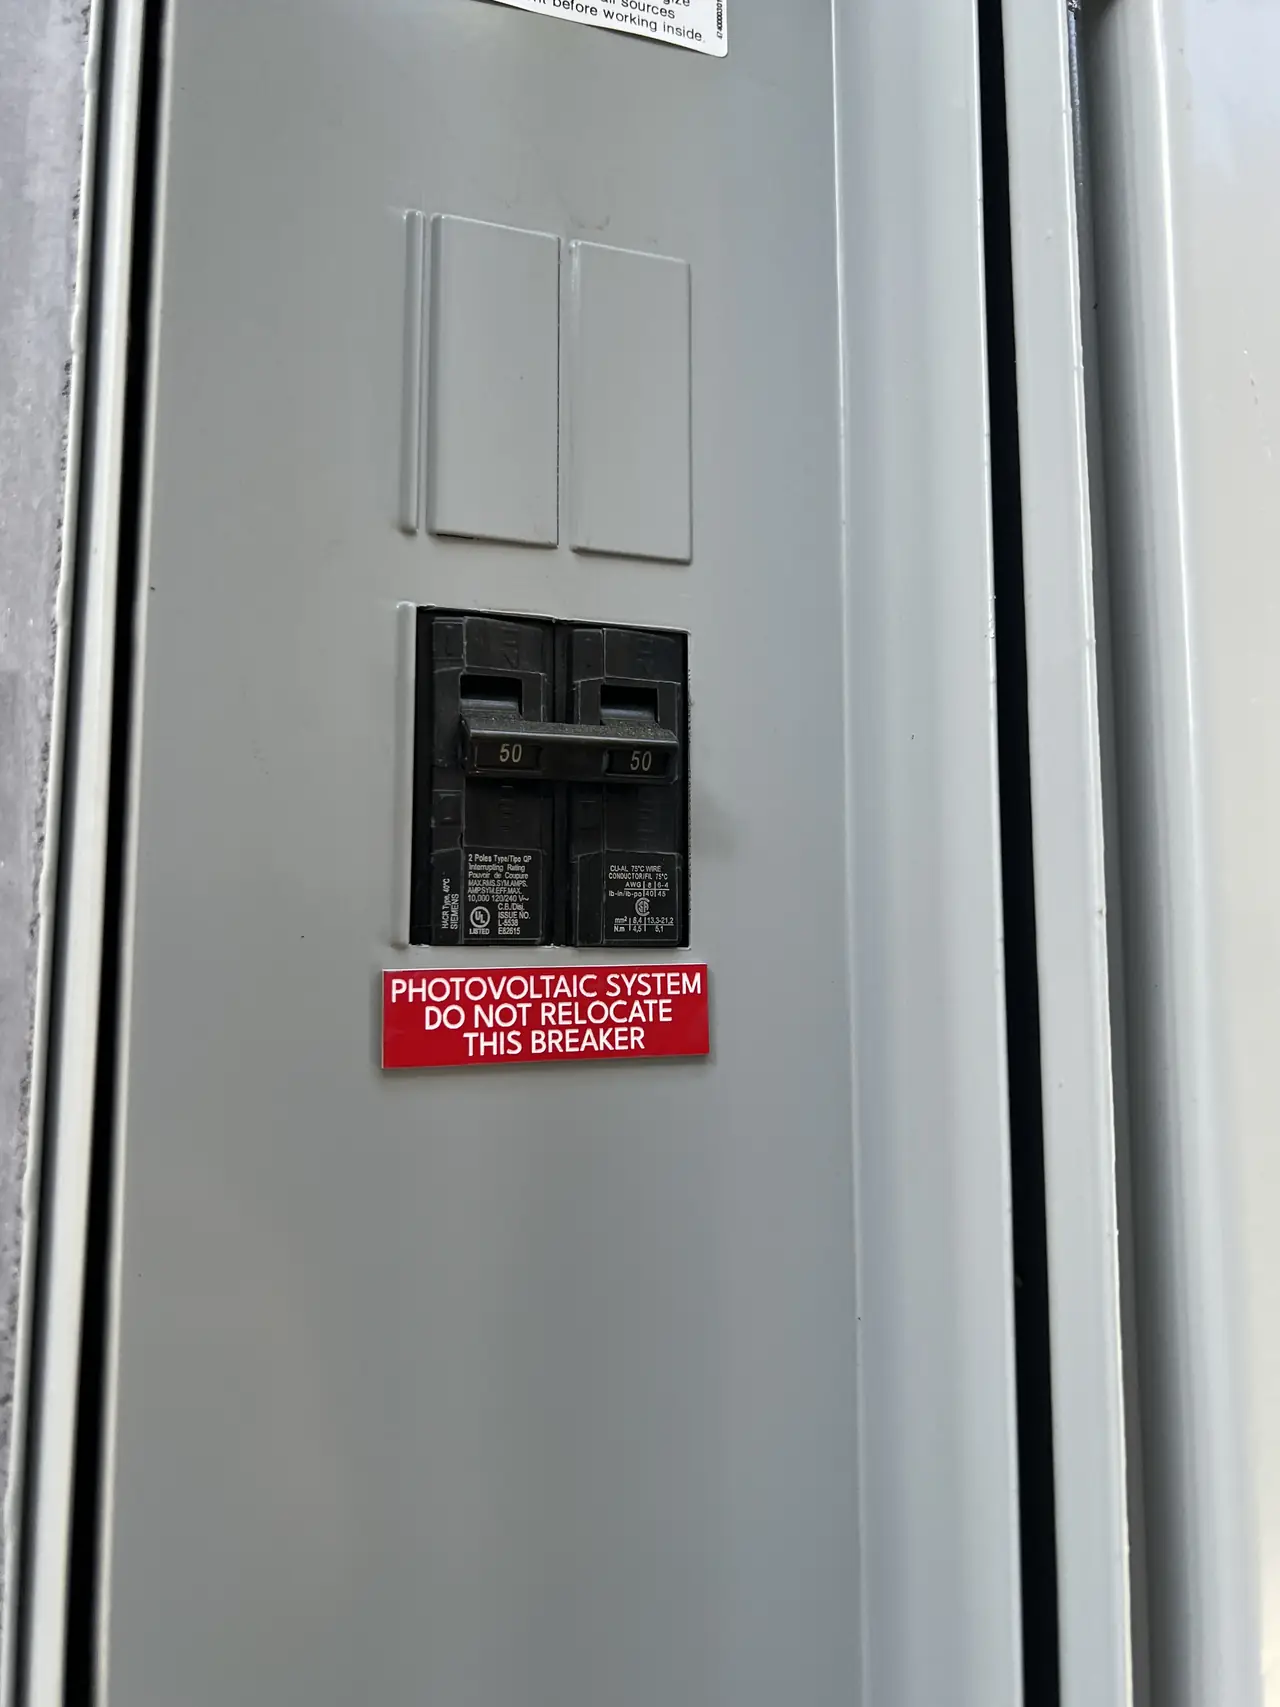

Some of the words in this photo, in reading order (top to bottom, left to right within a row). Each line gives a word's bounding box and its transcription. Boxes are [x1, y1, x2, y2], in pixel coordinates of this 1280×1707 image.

[621, 0, 676, 19] sources
[552, 0, 598, 16] before
[603, 9, 657, 32] working
[663, 21, 706, 43] inside.
[499, 743, 522, 763] 50
[629, 750, 652, 772] 50
[468, 854, 473, 862] 2
[474, 854, 492, 862] Poles
[468, 863, 504, 872] Interrupting
[507, 864, 526, 873] Rating
[468, 871, 491, 879] Pouvoir
[505, 872, 529, 880] Coupure
[609, 872, 652, 880] CONDUCTOR/FIL
[468, 895, 490, 903] 10,000
[441, 911, 450, 929] HACR
[450, 893, 459, 930] SIEMENS
[498, 911, 518, 919] ISSUE
[469, 927, 490, 935] LISTED
[391, 973, 598, 1003] PHOTOVOLTAIC
[605, 972, 702, 999] SYSTEM
[425, 1004, 466, 1031] DO
[474, 1002, 532, 1029] NOT
[541, 998, 673, 1027] RELOCATE
[462, 1030, 523, 1057] THIS
[531, 1026, 646, 1055] BREAKER
